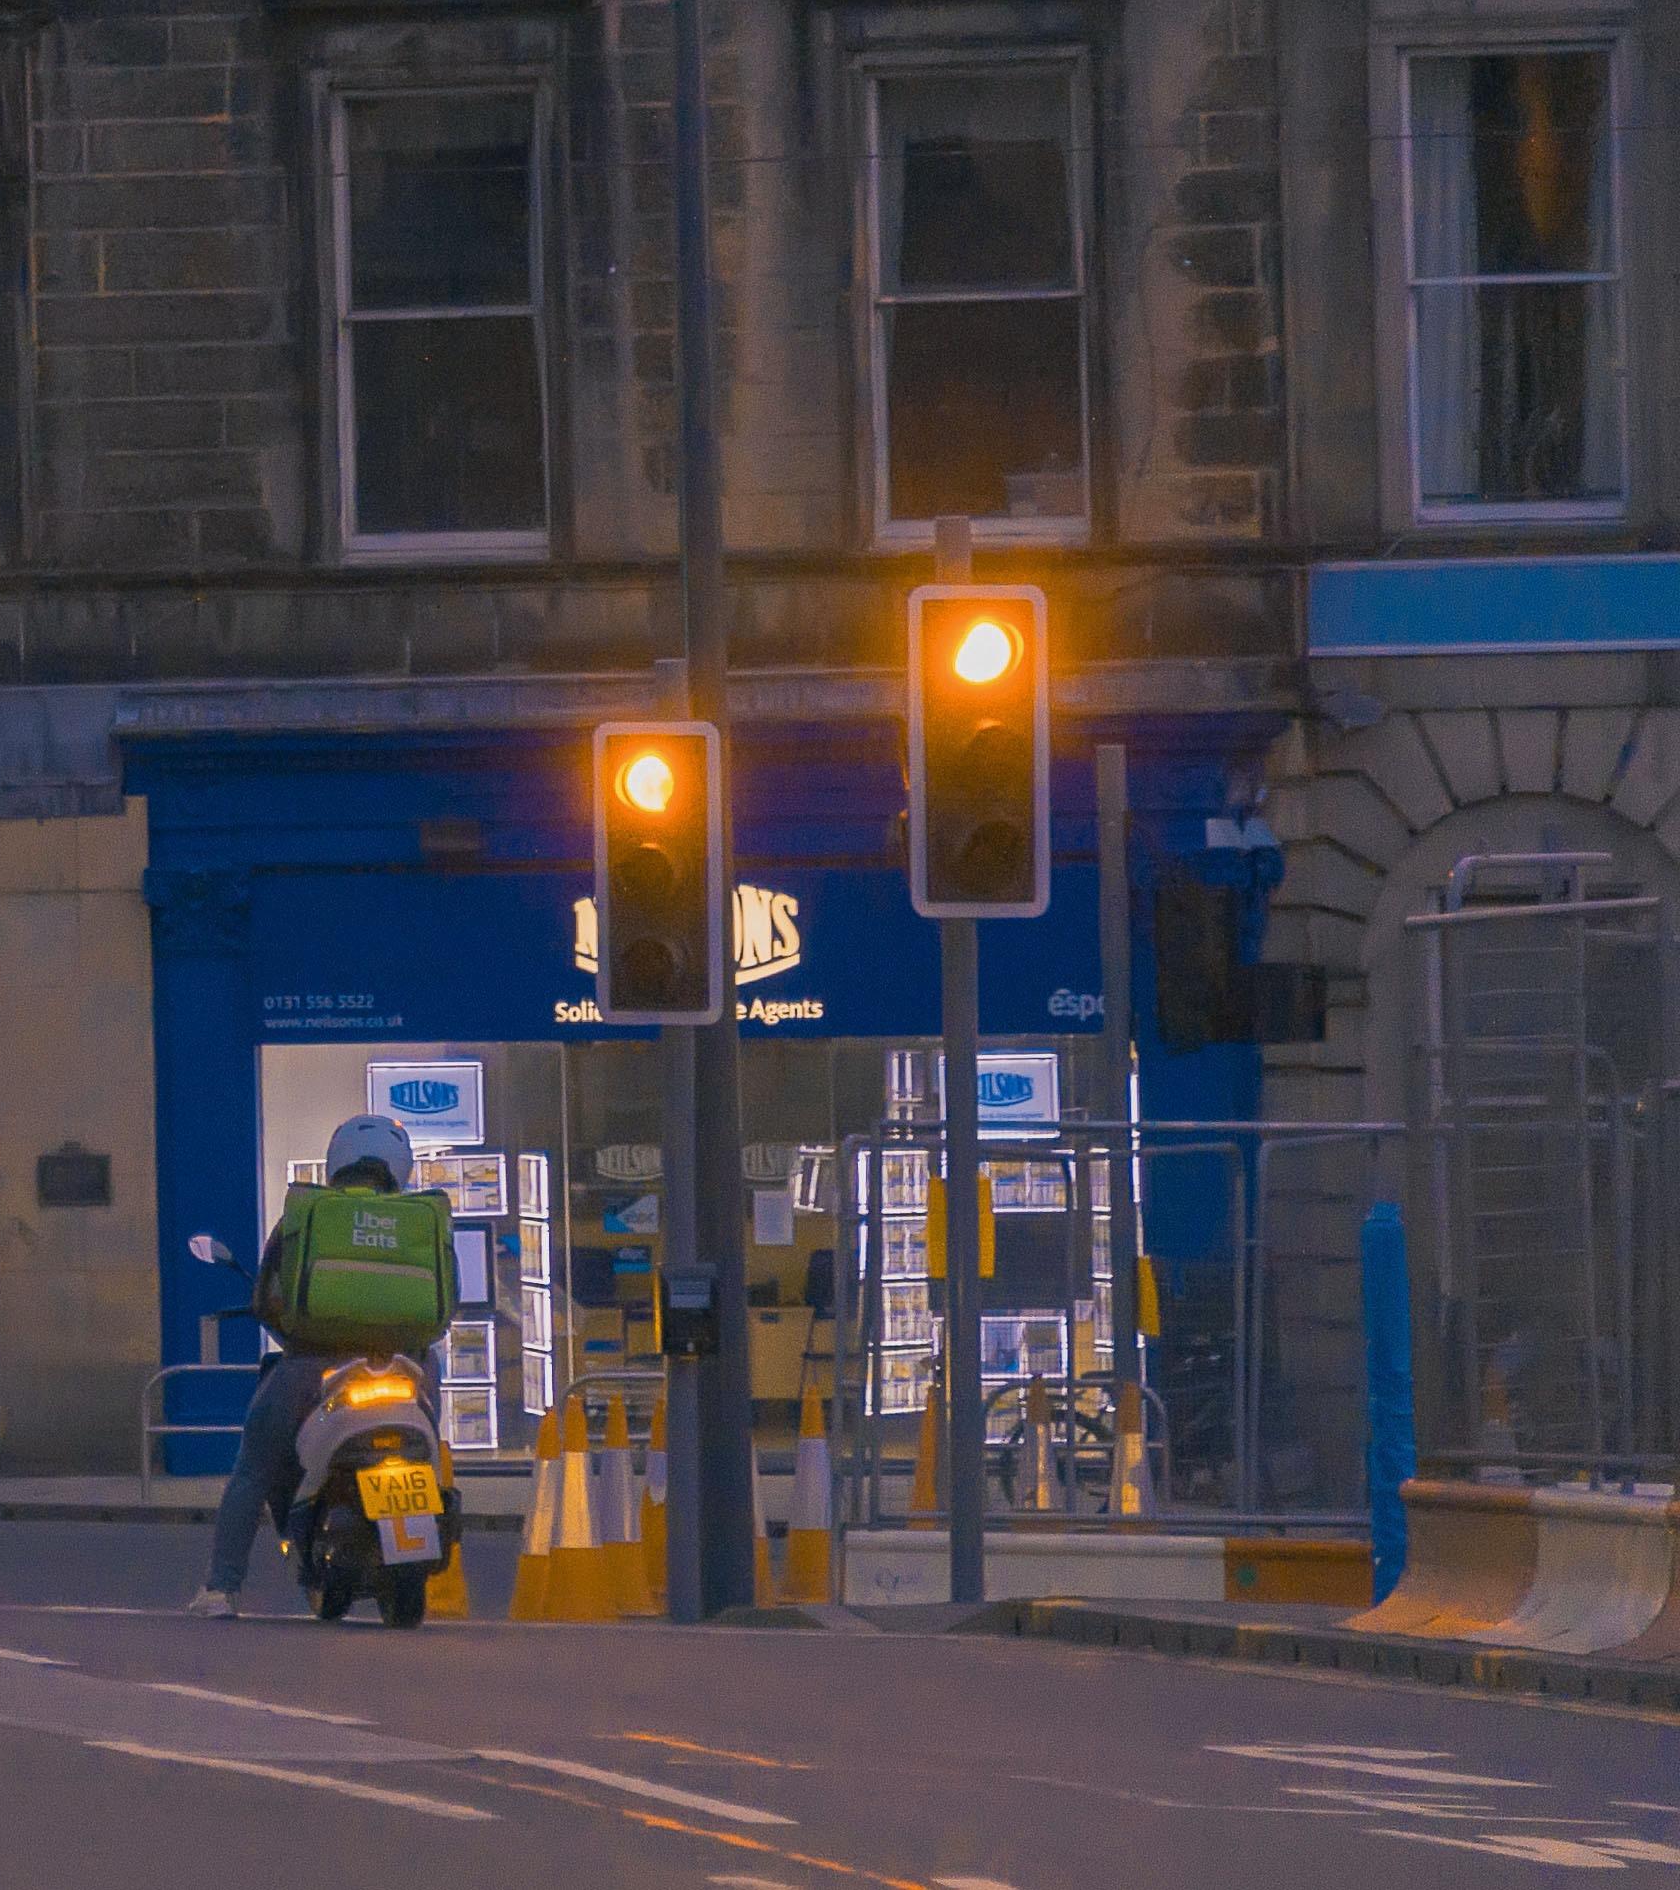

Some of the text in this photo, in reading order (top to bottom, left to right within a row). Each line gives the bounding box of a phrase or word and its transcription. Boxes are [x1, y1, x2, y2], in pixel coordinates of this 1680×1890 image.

[748, 998, 824, 1026] Agents
[353, 1210, 397, 1230] Uber
[352, 1229, 398, 1248] Eats
